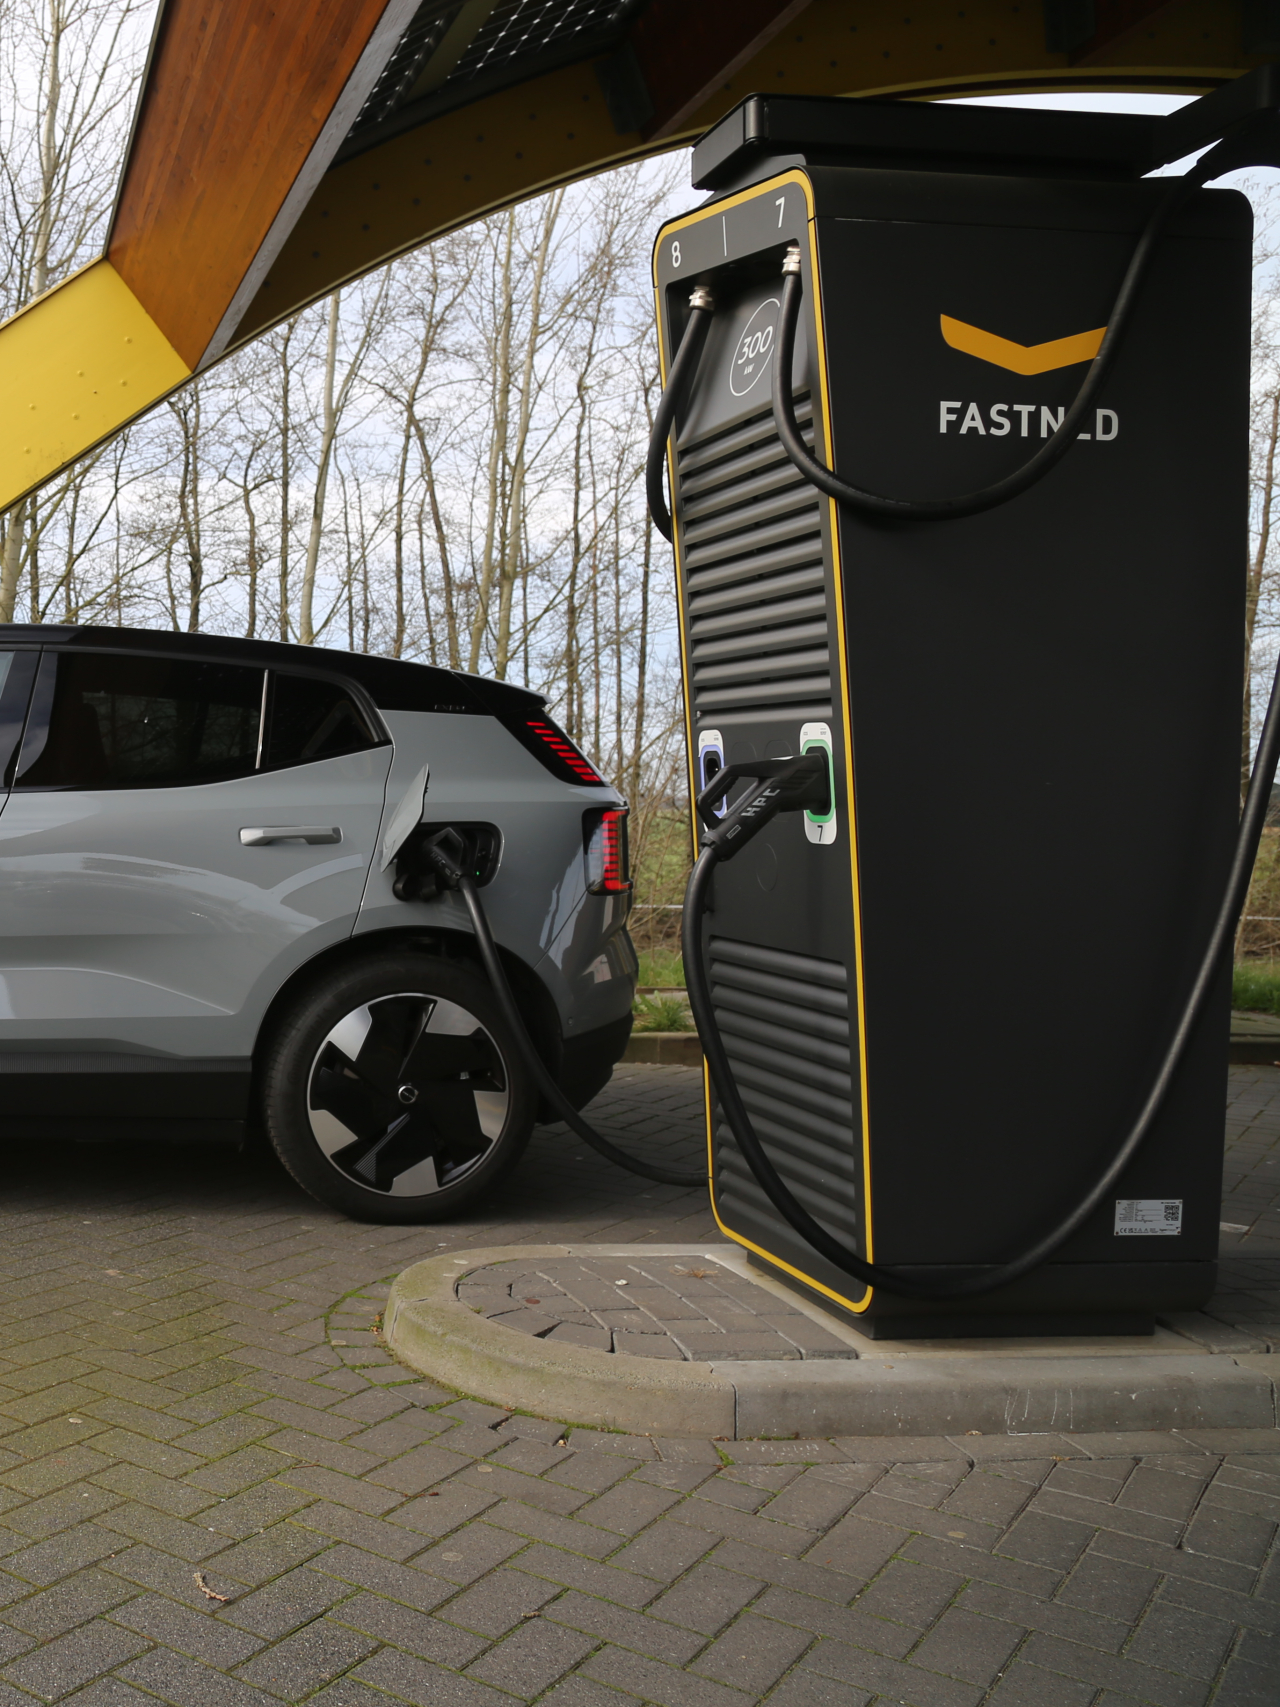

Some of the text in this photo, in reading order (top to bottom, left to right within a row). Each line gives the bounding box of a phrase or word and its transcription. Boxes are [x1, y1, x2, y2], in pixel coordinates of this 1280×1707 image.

[671, 196, 785, 268] 8 7
[737, 325, 773, 365] 300
[939, 401, 1119, 441] FASTND
[740, 788, 780, 817] HPC
[817, 824, 824, 842] 7
